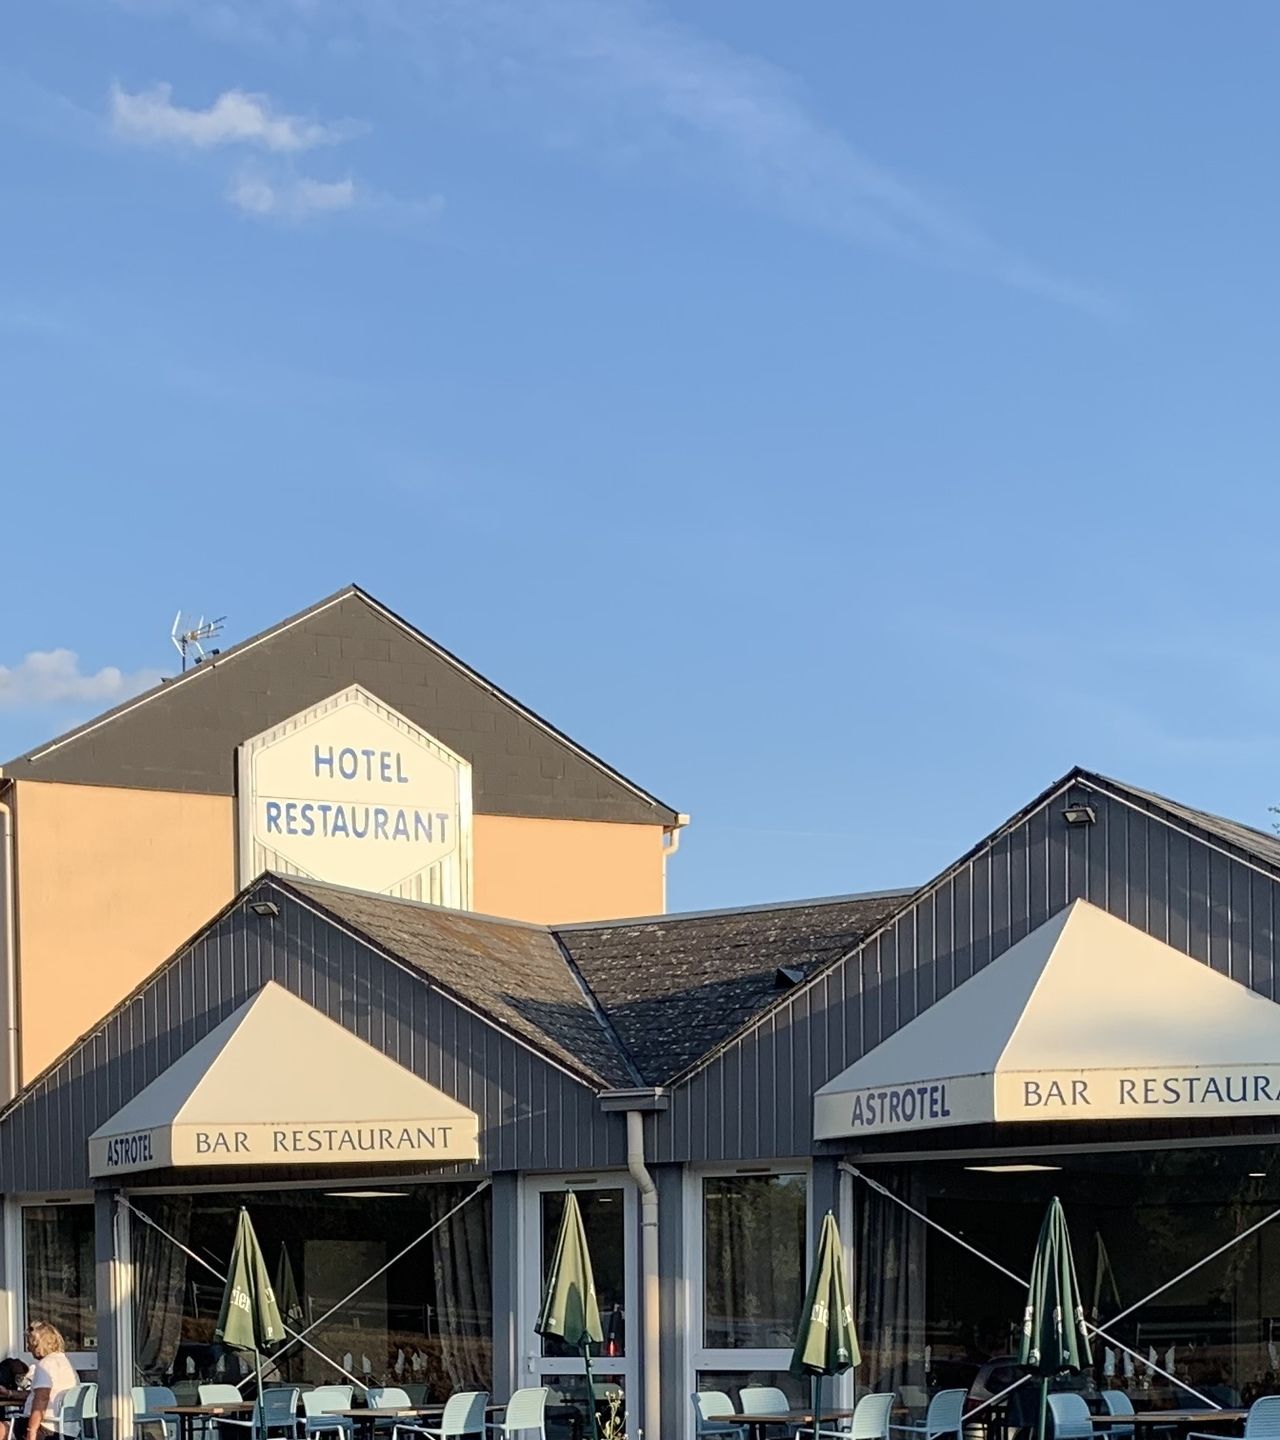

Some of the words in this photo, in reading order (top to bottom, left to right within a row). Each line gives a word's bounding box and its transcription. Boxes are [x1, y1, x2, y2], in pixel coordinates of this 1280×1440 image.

[314, 744, 409, 783] HOTEL
[265, 801, 450, 843] RESTAURANT
[850, 1084, 952, 1127] ASTROTEL
[1023, 1080, 1091, 1107] BAR
[106, 1133, 154, 1167] ASTROTEL
[196, 1131, 250, 1154] BAR
[272, 1127, 452, 1152] RESTAURANT
